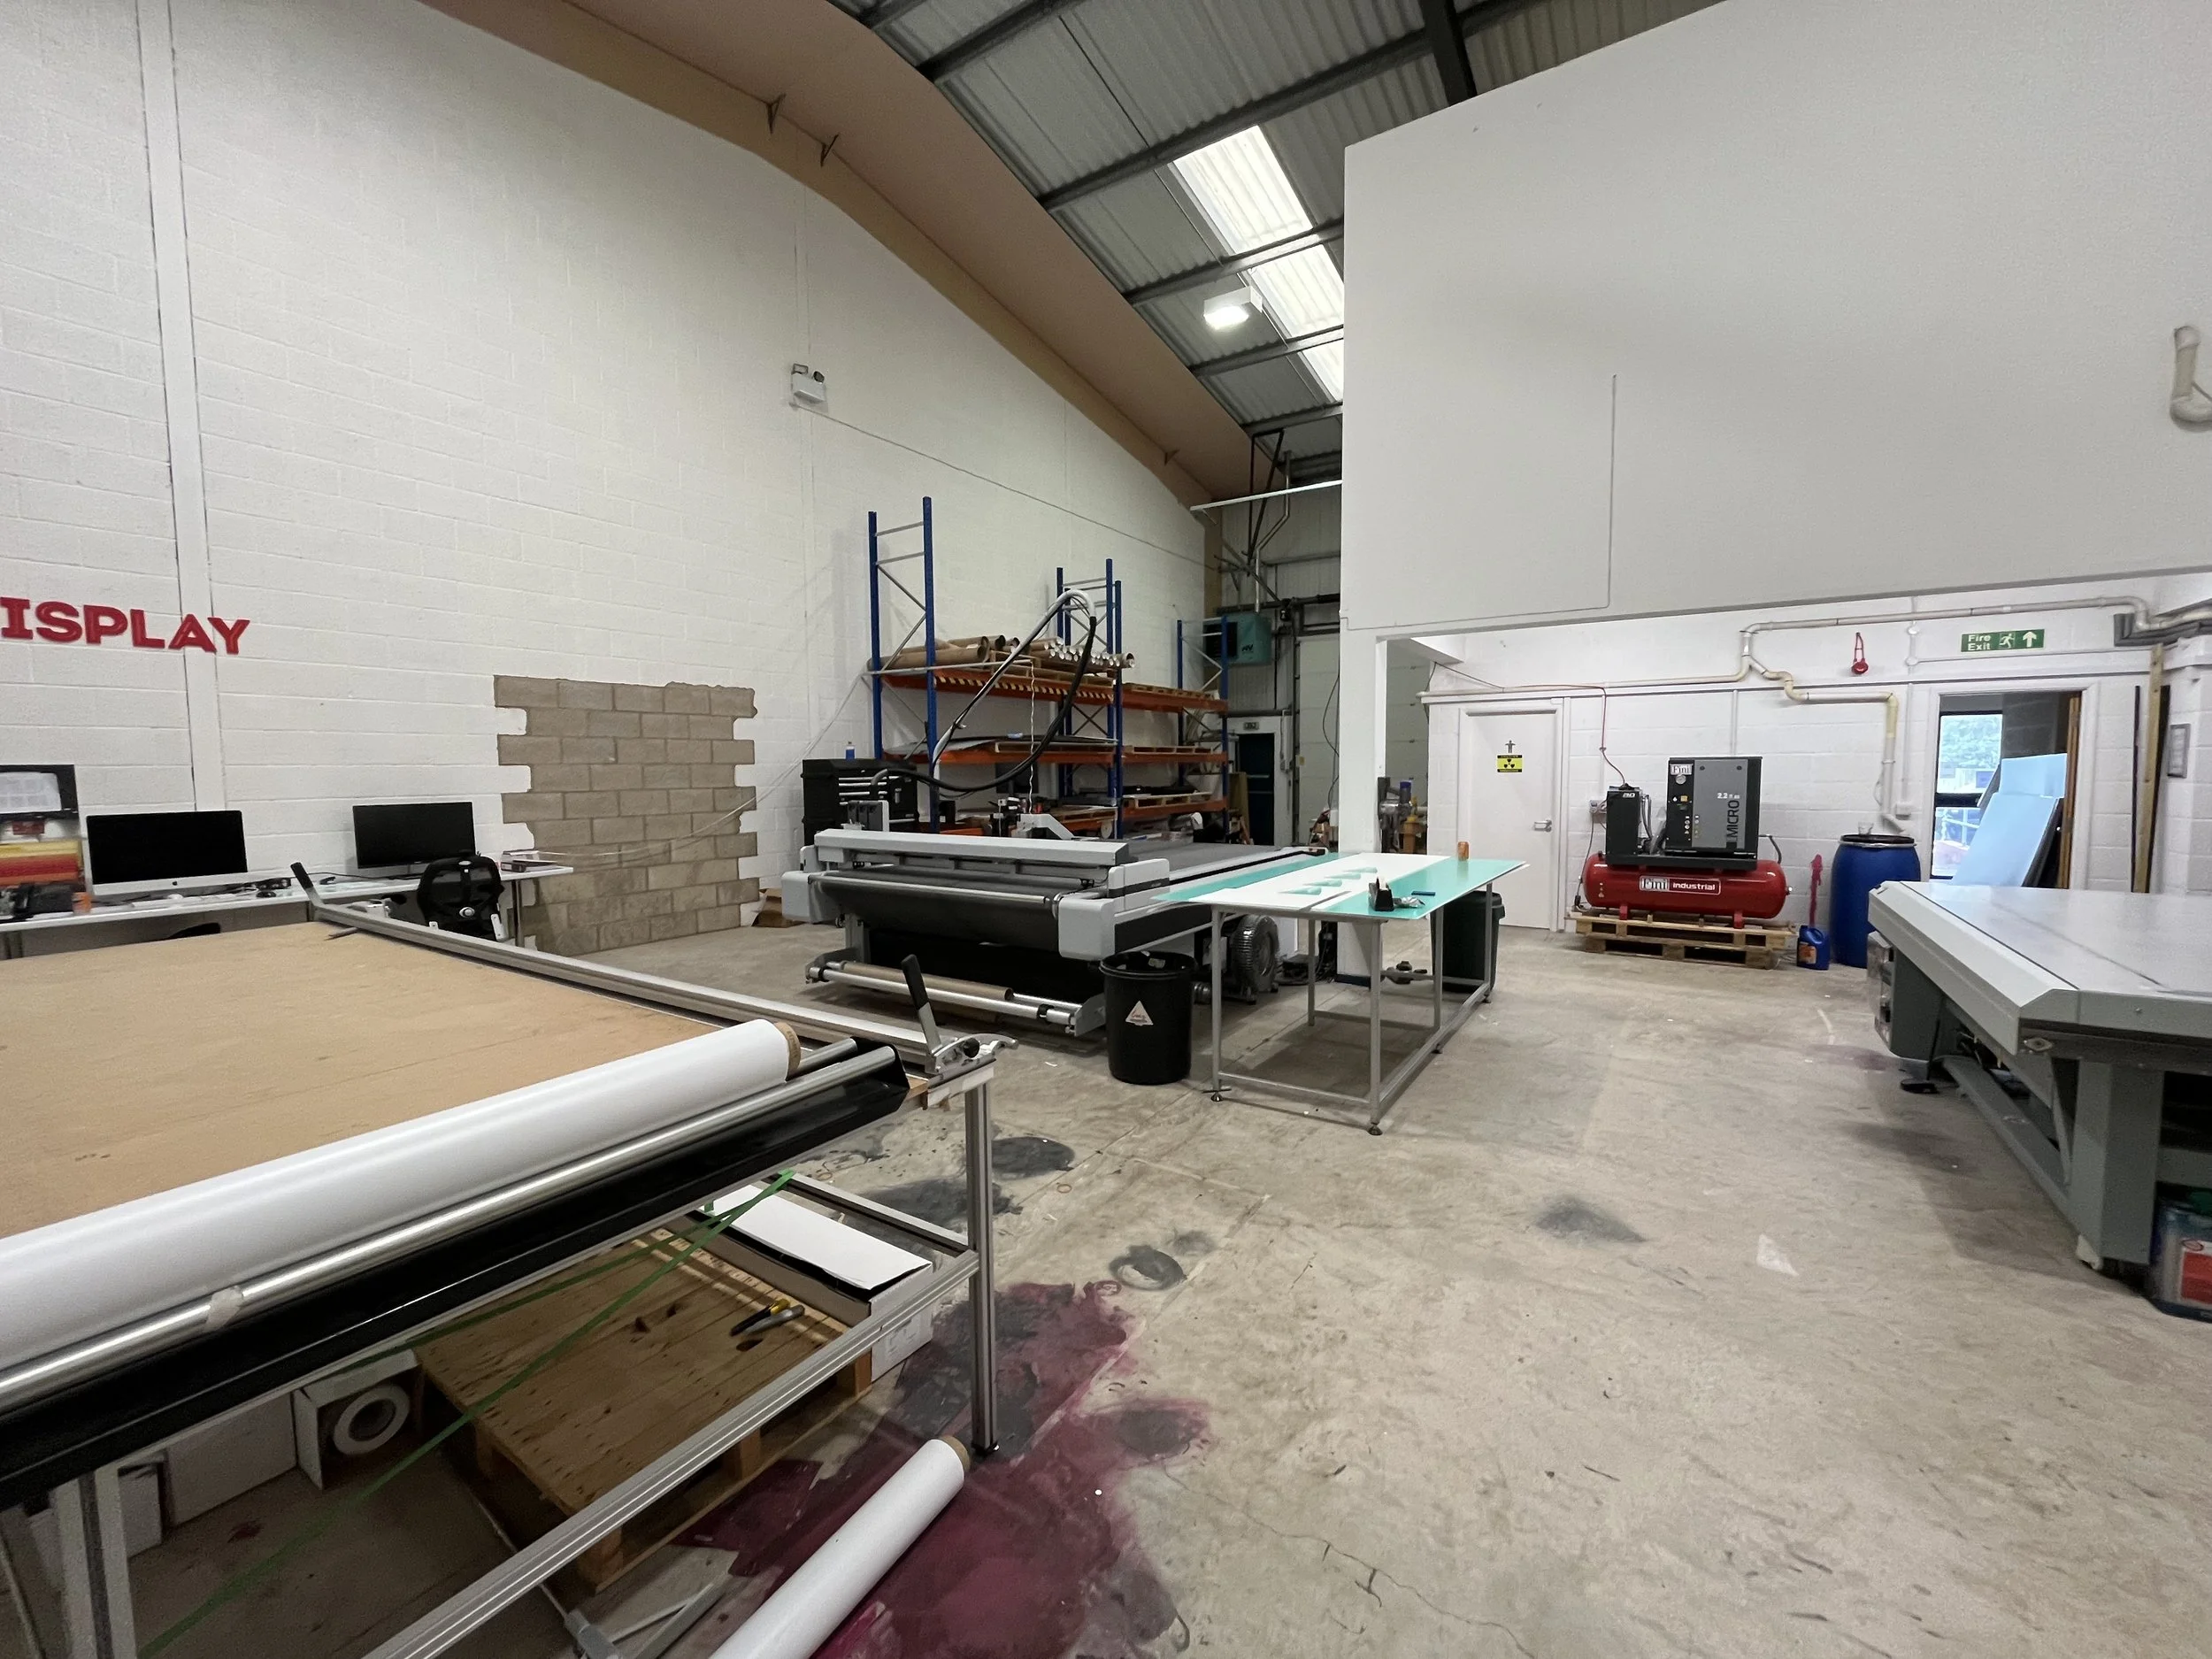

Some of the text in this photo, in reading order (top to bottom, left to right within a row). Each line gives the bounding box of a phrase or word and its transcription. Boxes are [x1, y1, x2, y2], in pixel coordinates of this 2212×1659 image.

[1967, 642, 1991, 651] Exit
[1672, 764, 1690, 774] Fini
[1726, 800, 1740, 838] MICRO
[1643, 878, 1716, 891] Fini industrial
